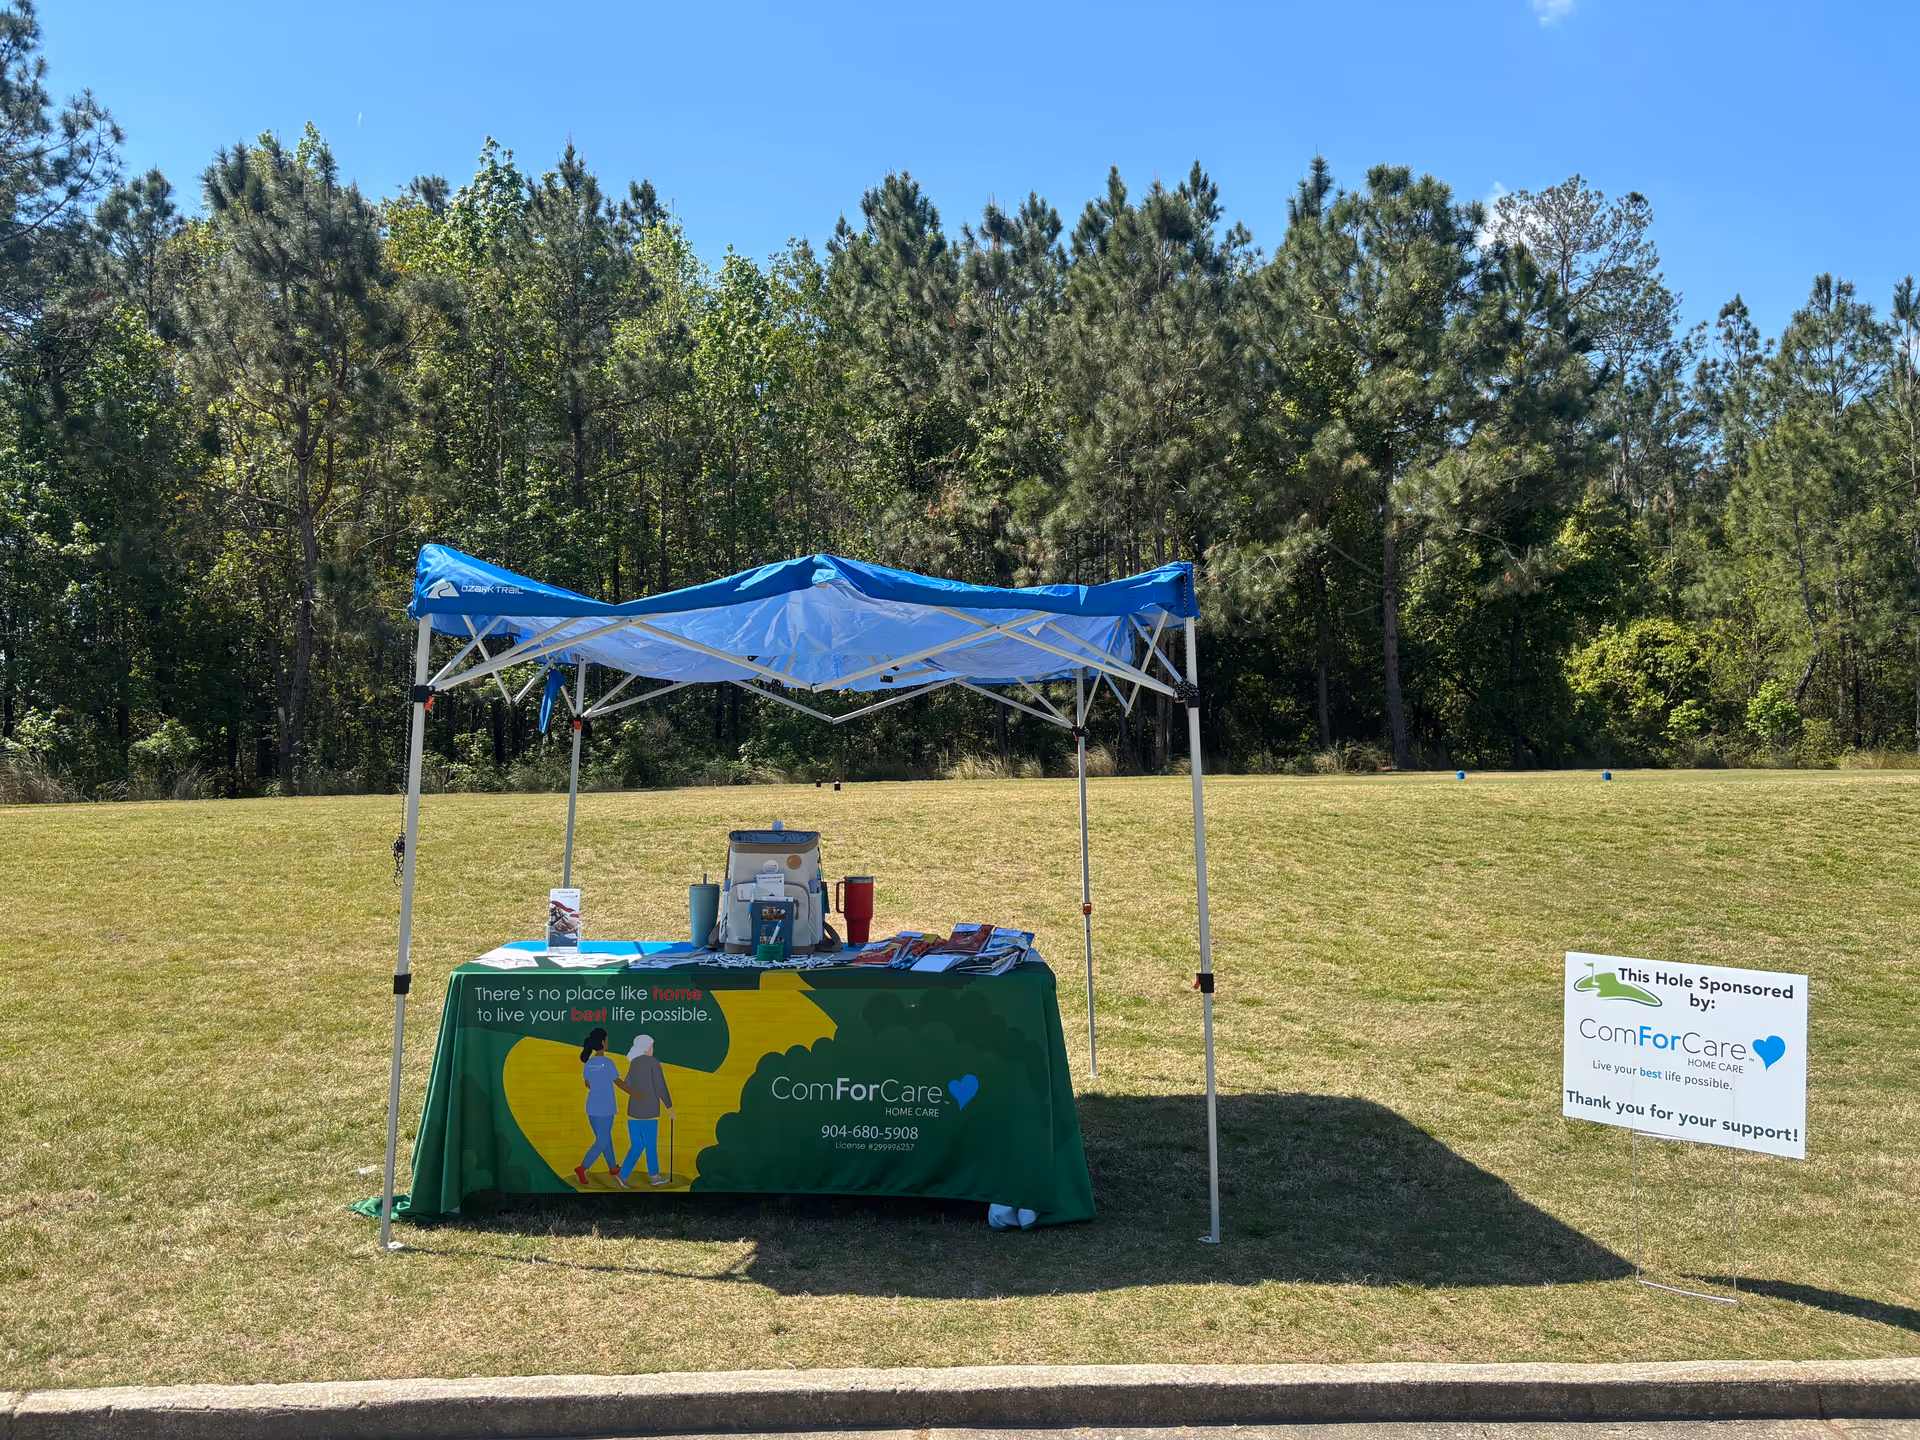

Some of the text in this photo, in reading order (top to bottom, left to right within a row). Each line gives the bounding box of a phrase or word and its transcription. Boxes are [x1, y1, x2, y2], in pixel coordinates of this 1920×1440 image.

[461, 585, 523, 595] OZARK TRAIL
[1618, 967, 1794, 999] This Hole Sponsored
[475, 985, 702, 1003] There's no place like home
[1689, 993, 1716, 1012] by:
[477, 1007, 712, 1024] to live your best life possible.
[1579, 1018, 1747, 1061] ComForCare
[1687, 1057, 1744, 1074] HOME CARE
[1592, 1060, 1733, 1091] Live your best life possible.
[771, 1076, 943, 1104] ComForCare
[885, 1107, 939, 1118] HOME CARE
[1566, 1090, 1799, 1142] Thank you for your support!
[821, 1124, 919, 1140] 904-680-5908
[835, 1141, 915, 1151] License #299996257
